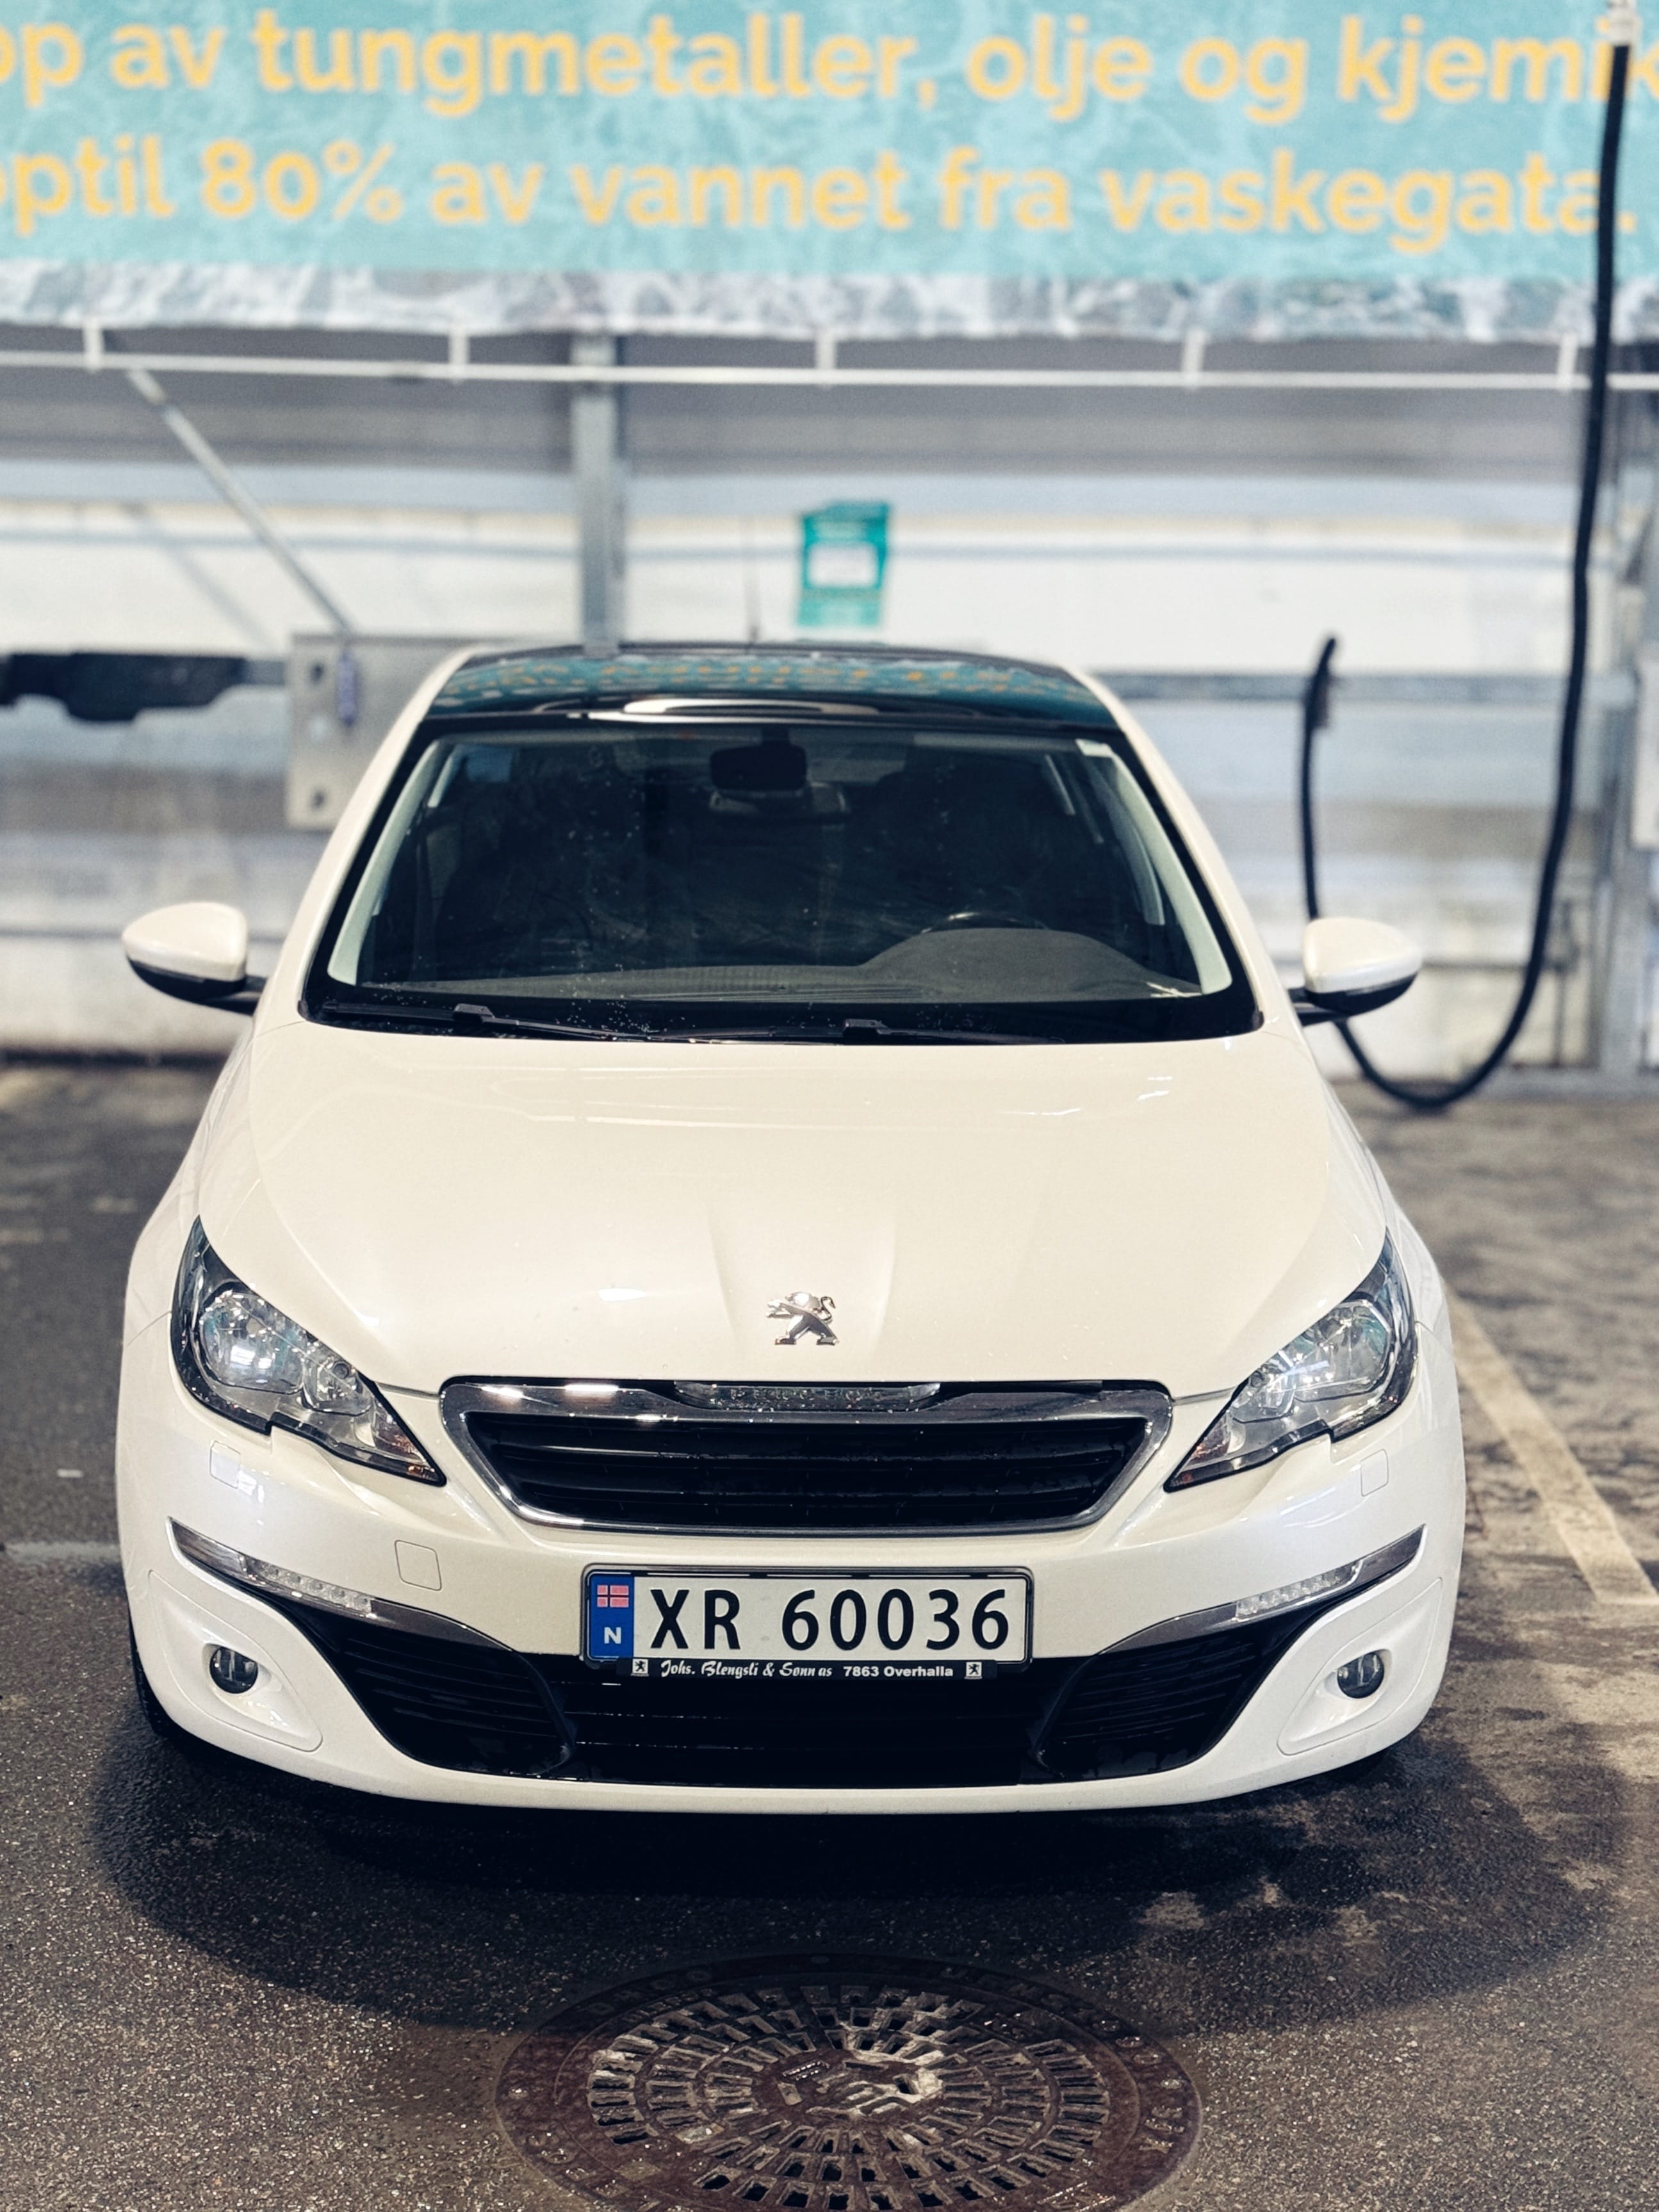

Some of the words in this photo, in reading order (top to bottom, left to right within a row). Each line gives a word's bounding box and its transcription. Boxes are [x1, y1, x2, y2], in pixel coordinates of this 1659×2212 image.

[0, 22, 83, 108] p
[110, 24, 224, 88] av
[252, 10, 935, 117] tungmetaller,
[966, 15, 1152, 122] olje
[1180, 37, 1307, 124] og
[0, 134, 175, 237] ptil
[200, 138, 402, 222] 80%
[430, 162, 543, 224] av
[569, 151, 910, 230] vannet
[936, 146, 1071, 231] fra
[1100, 149, 1637, 254] vaskegata.
[604, 1627, 621, 1644] N
[650, 1589, 740, 1649] XR
[781, 1588, 1009, 1650] 60036
[660, 1659, 695, 1678] Johs.
[701, 1661, 759, 1679] Blengsli
[762, 1662, 774, 1677] &
[818, 1667, 832, 1677] as
[843, 1666, 879, 1677] 7863
[883, 1666, 953, 1677] Overhalla
